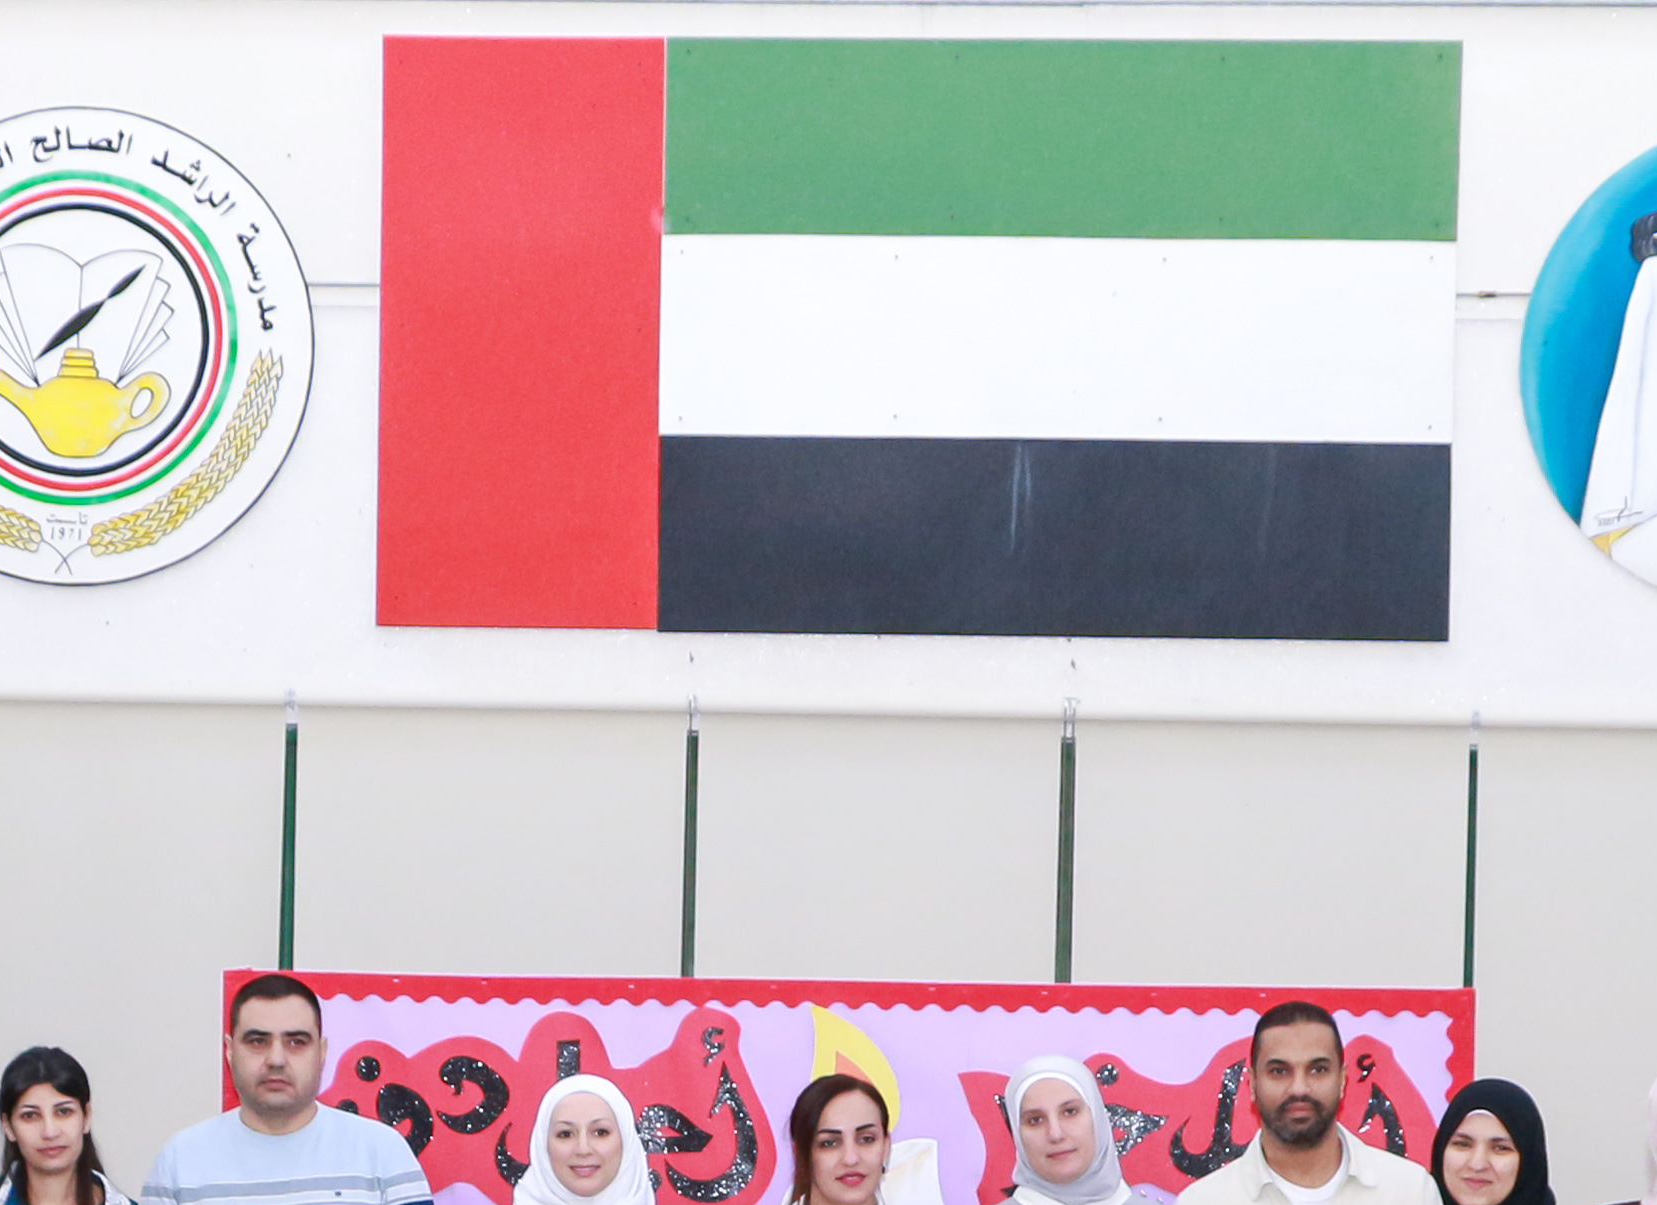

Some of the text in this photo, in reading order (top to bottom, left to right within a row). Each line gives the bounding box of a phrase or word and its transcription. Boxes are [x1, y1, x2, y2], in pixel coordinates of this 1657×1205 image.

[31, 126, 133, 163] الصالح
[150, 149, 237, 217] الراشد
[236, 221, 278, 332] مدرسة
